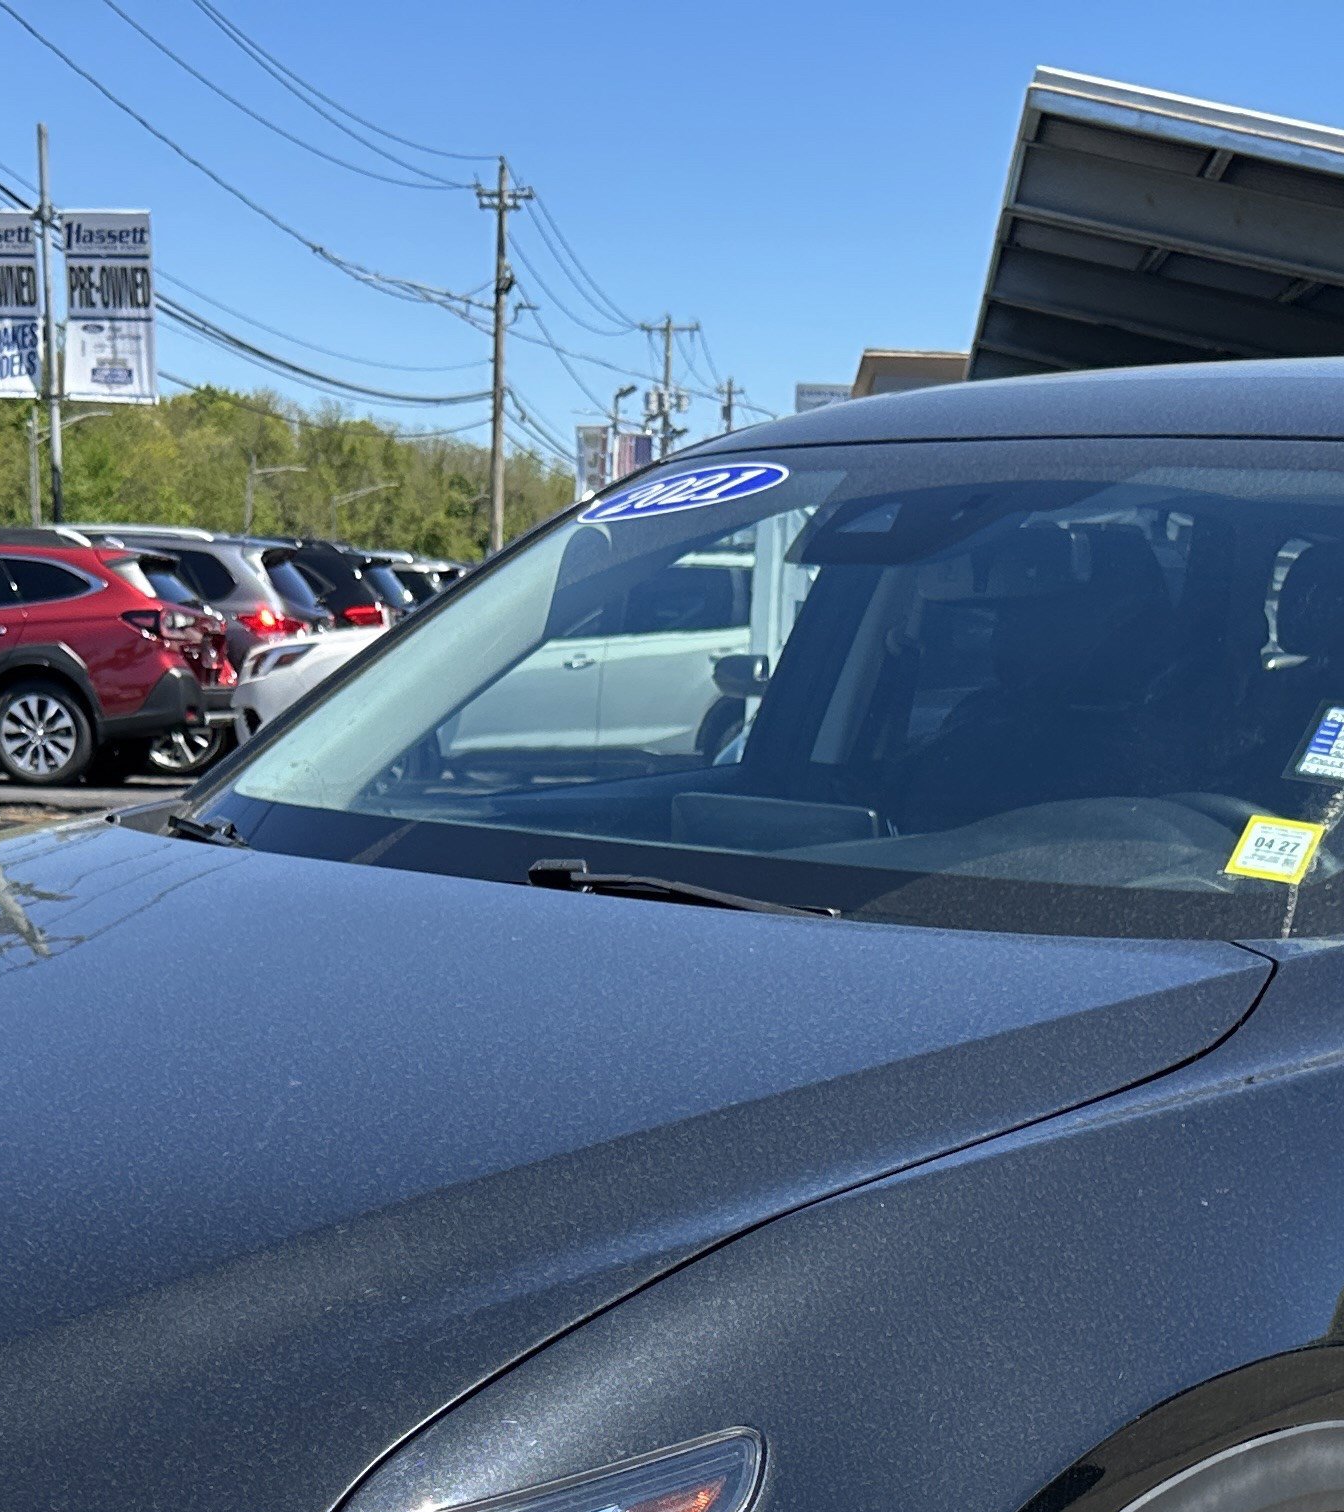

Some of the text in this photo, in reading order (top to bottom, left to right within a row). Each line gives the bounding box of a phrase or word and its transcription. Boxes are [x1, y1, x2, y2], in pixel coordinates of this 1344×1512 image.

[593, 468, 769, 519] 2021
[1254, 837, 1300, 853] 04 27
